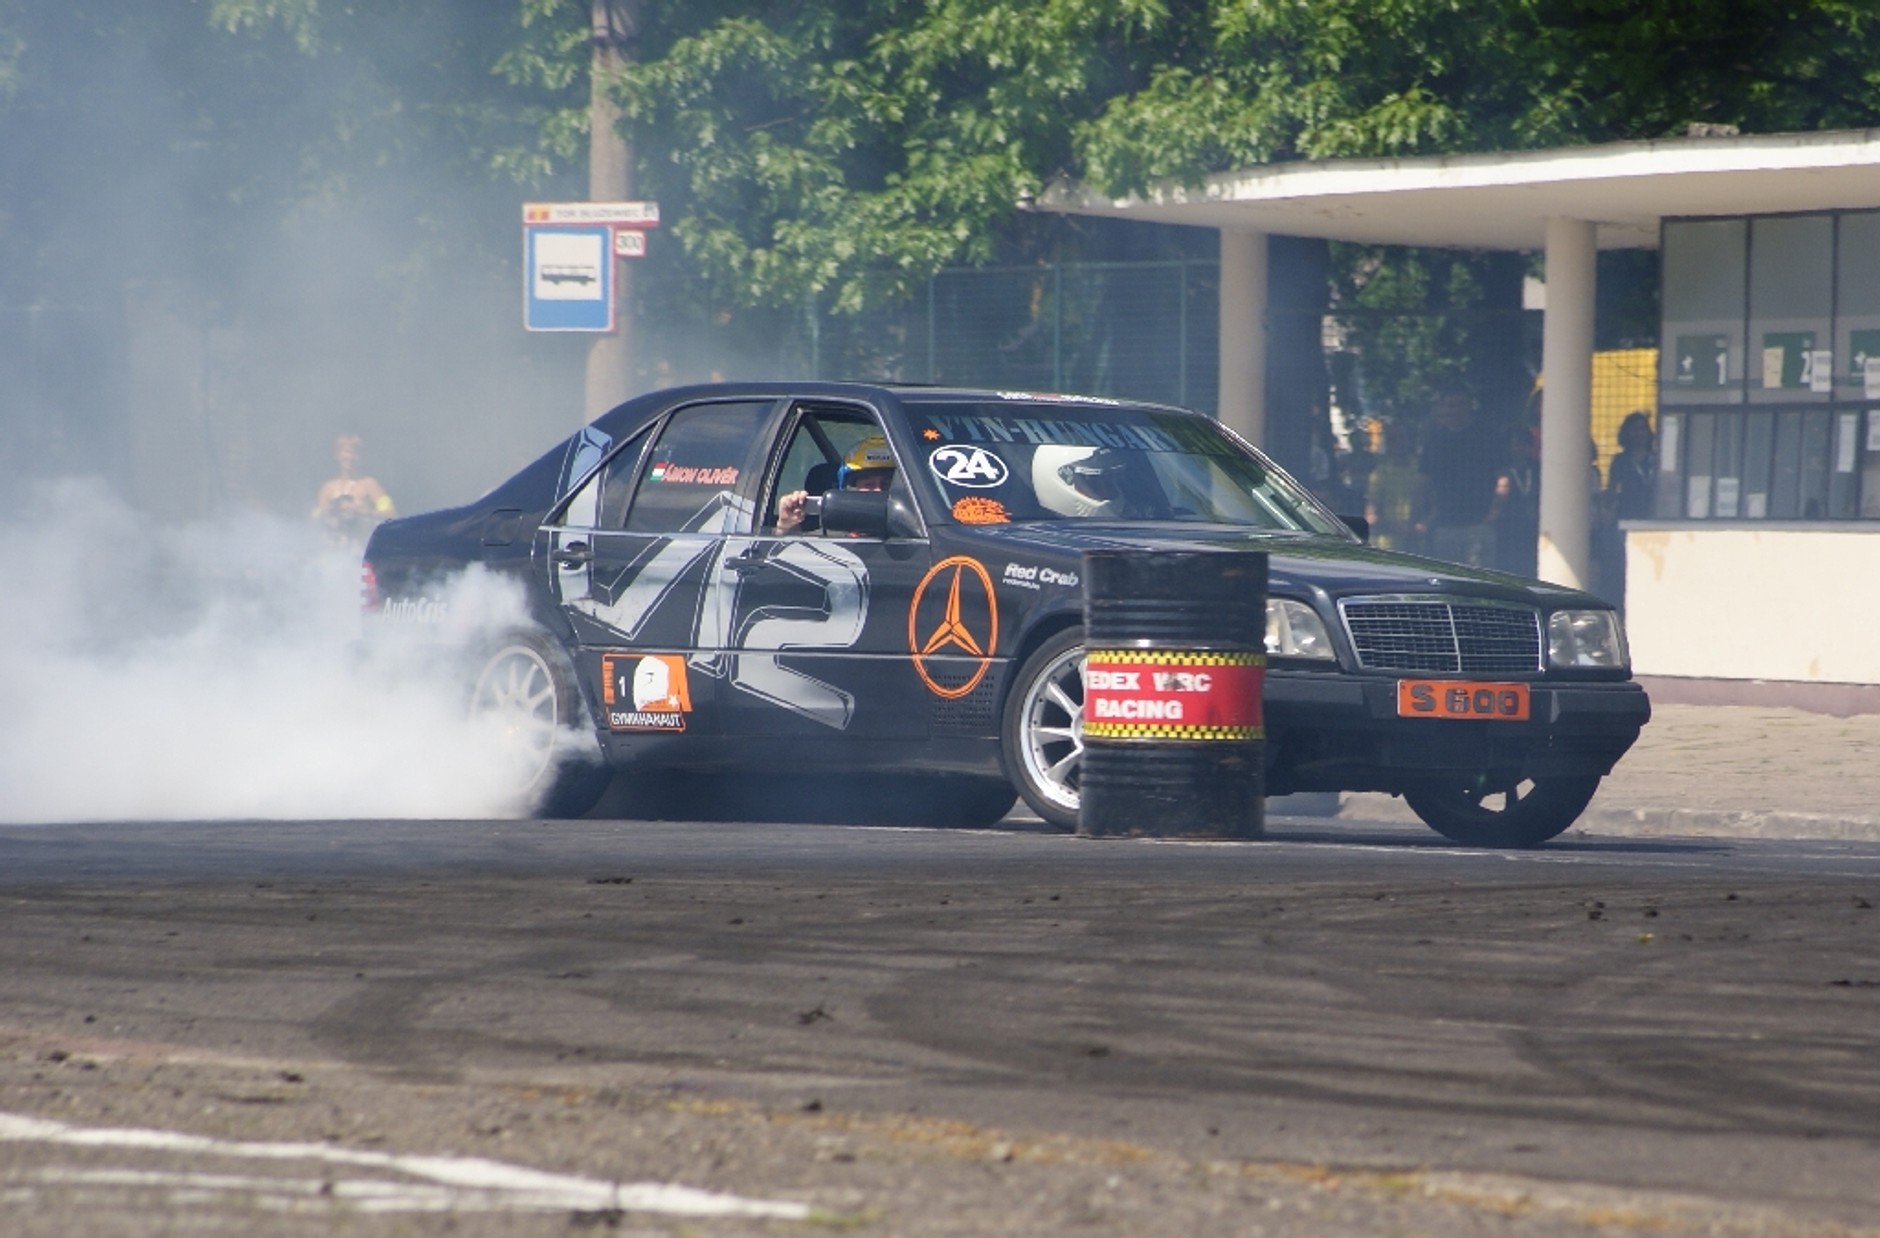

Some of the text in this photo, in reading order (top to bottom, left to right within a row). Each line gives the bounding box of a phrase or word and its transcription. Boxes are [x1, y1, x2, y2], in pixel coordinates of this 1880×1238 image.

[1004, 562, 1079, 587] Red Crab
[1095, 697, 1184, 719] RACING
[1411, 684, 1520, 716] S 600
